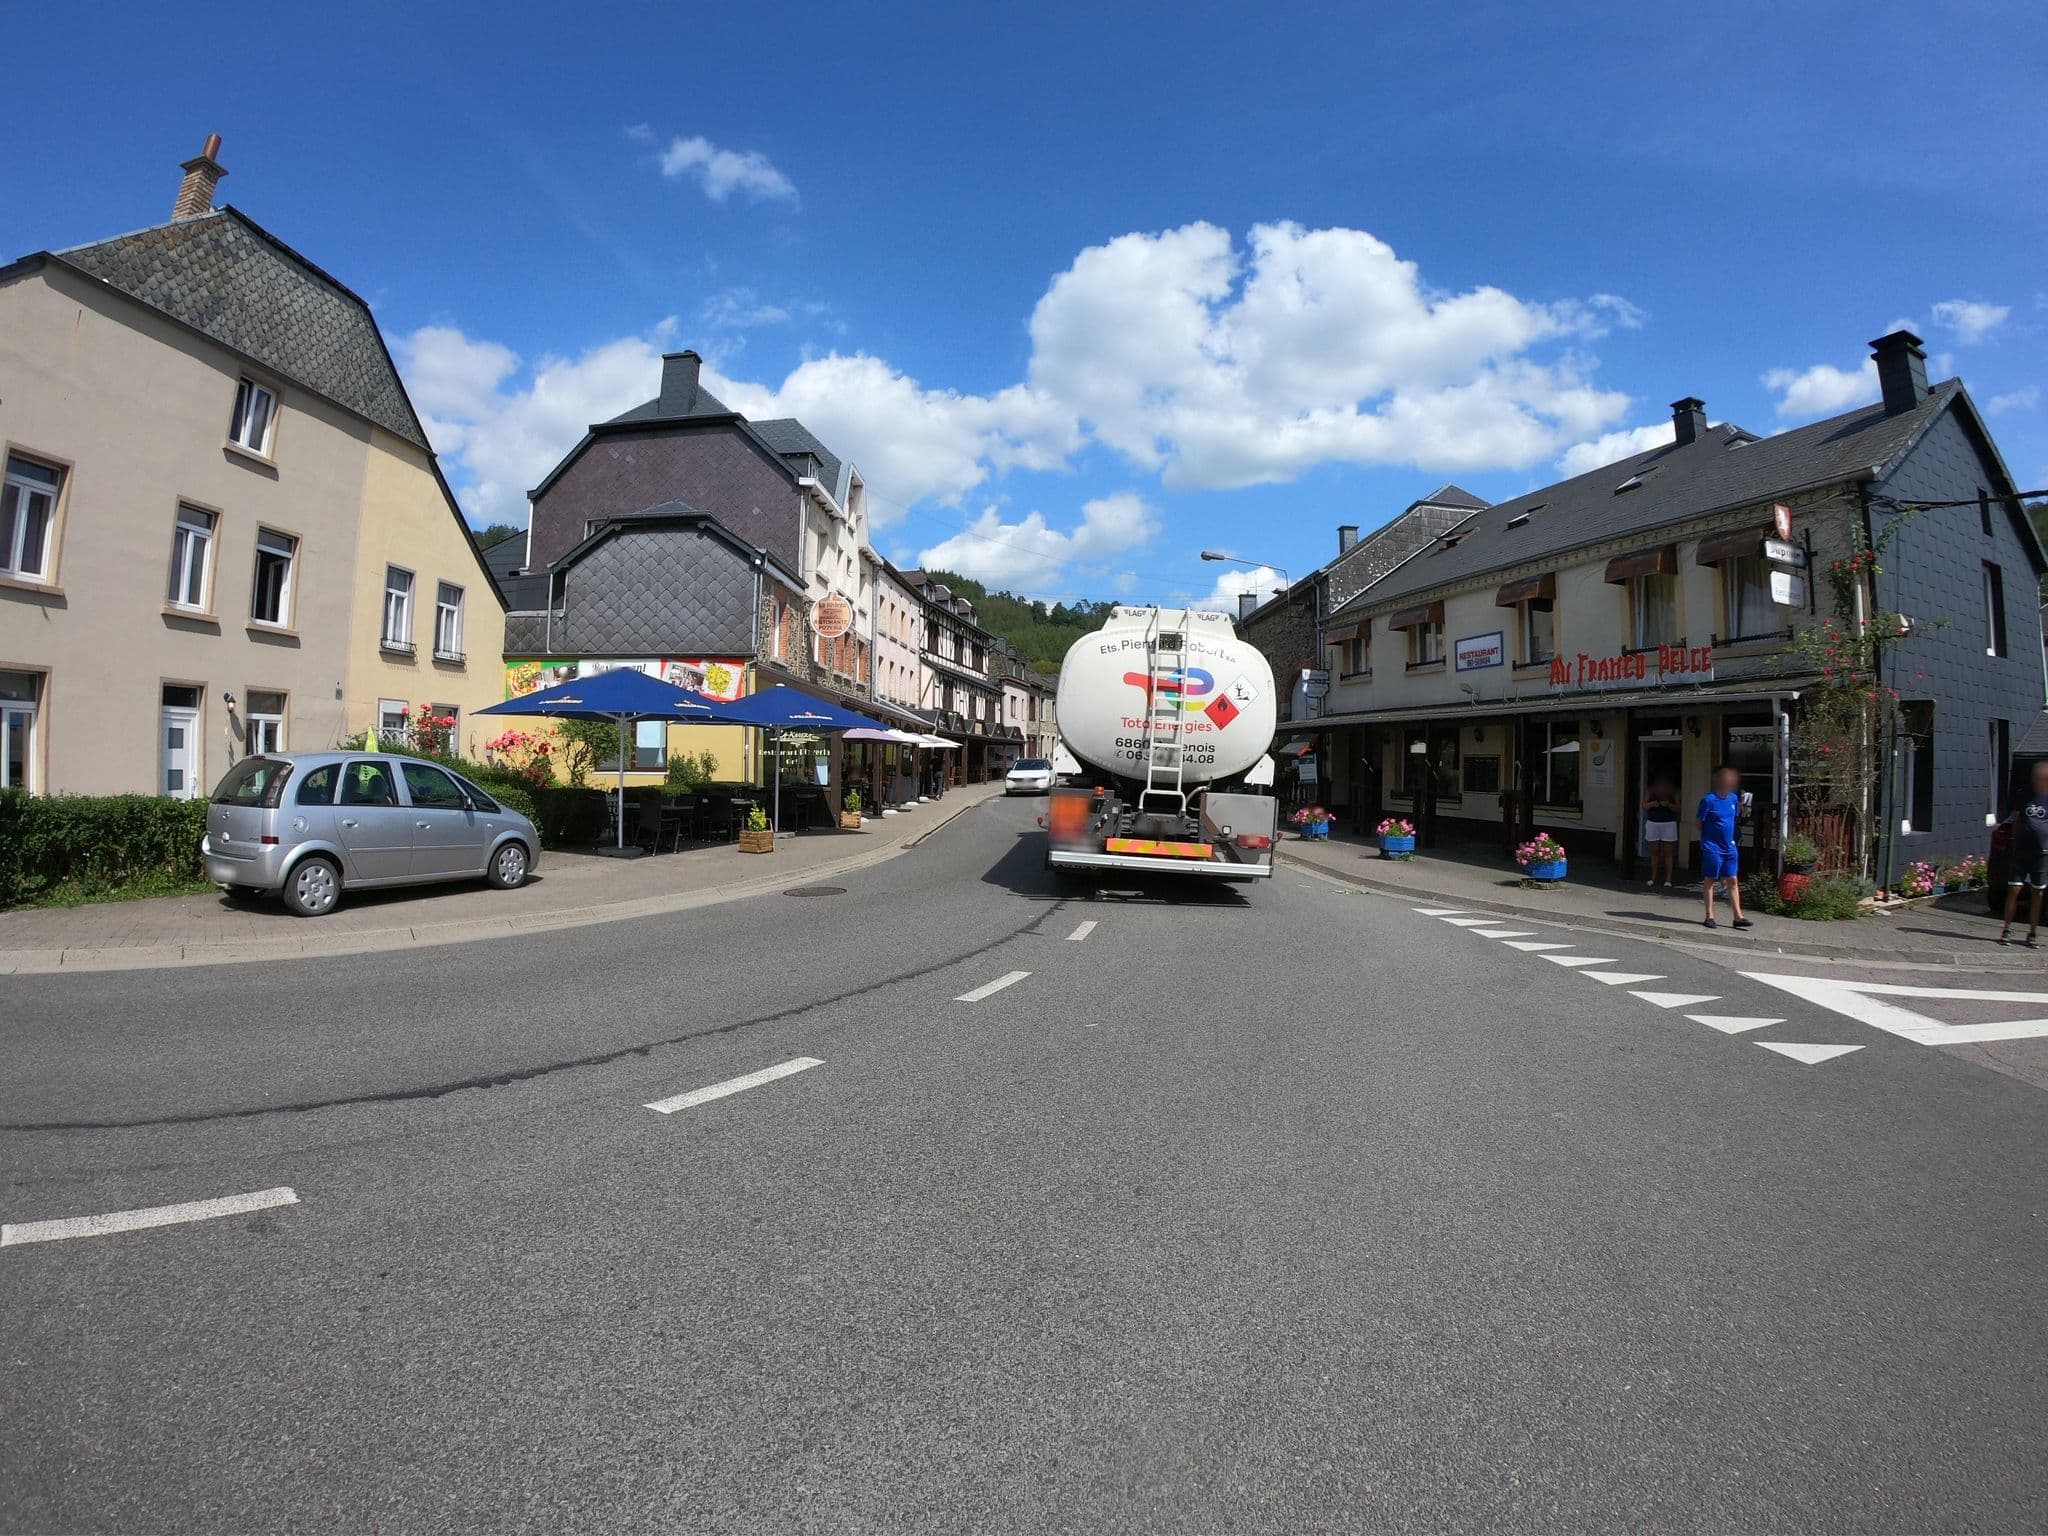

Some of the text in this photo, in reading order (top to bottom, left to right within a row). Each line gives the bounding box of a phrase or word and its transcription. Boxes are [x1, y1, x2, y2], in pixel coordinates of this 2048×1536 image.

[1100, 644, 1120, 655] Ets.
[1459, 647, 1499, 660] RESTAURANT
[1115, 737, 1151, 750] 6860
